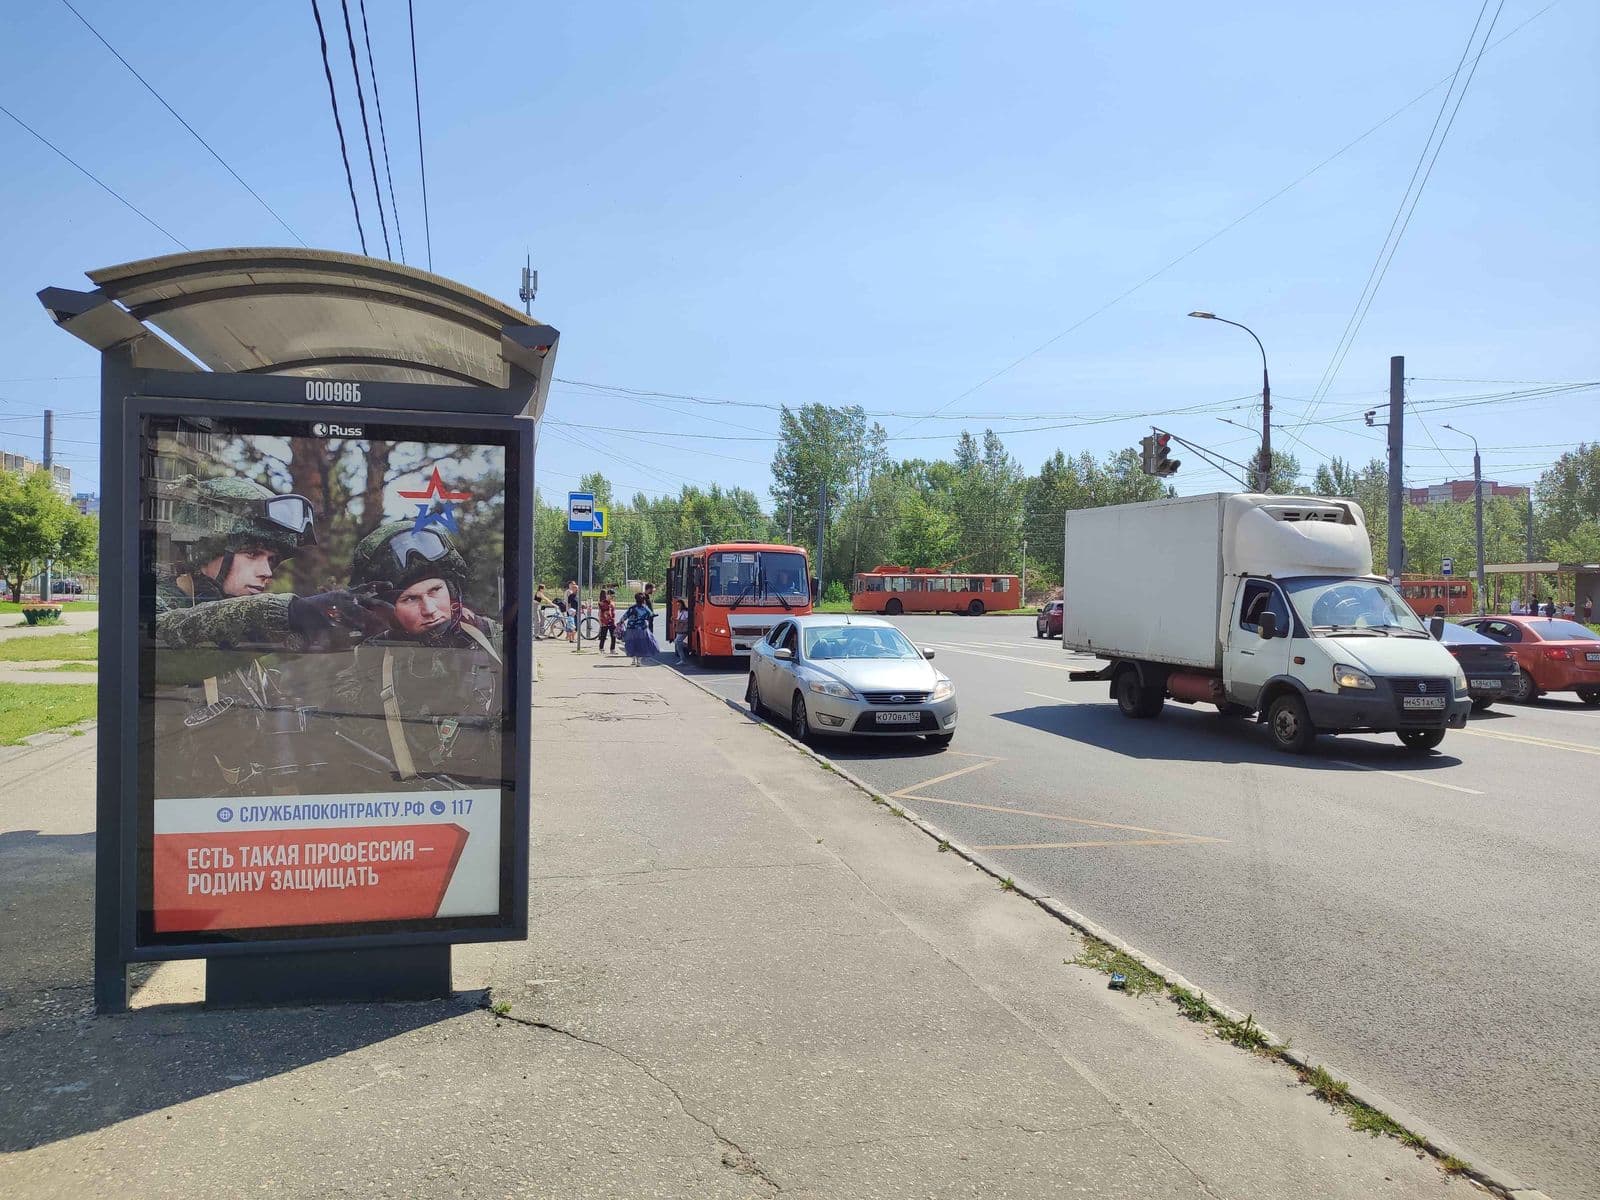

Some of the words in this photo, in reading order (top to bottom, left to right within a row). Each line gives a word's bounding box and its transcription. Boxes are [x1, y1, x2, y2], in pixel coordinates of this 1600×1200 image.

[329, 425, 362, 436] Russ
[240, 801, 425, 822] СЛУЖБАПОКОНТРАКТУ.РФ
[452, 799, 473, 815] 117
[187, 847, 234, 870] ЕСТЬ
[239, 844, 299, 868] ТАКАЯ
[304, 840, 415, 865] ПРОФЕССИЯ
[187, 871, 266, 896] РОДИНУ
[270, 866, 379, 891] ЗАЩИЩАТЬ
